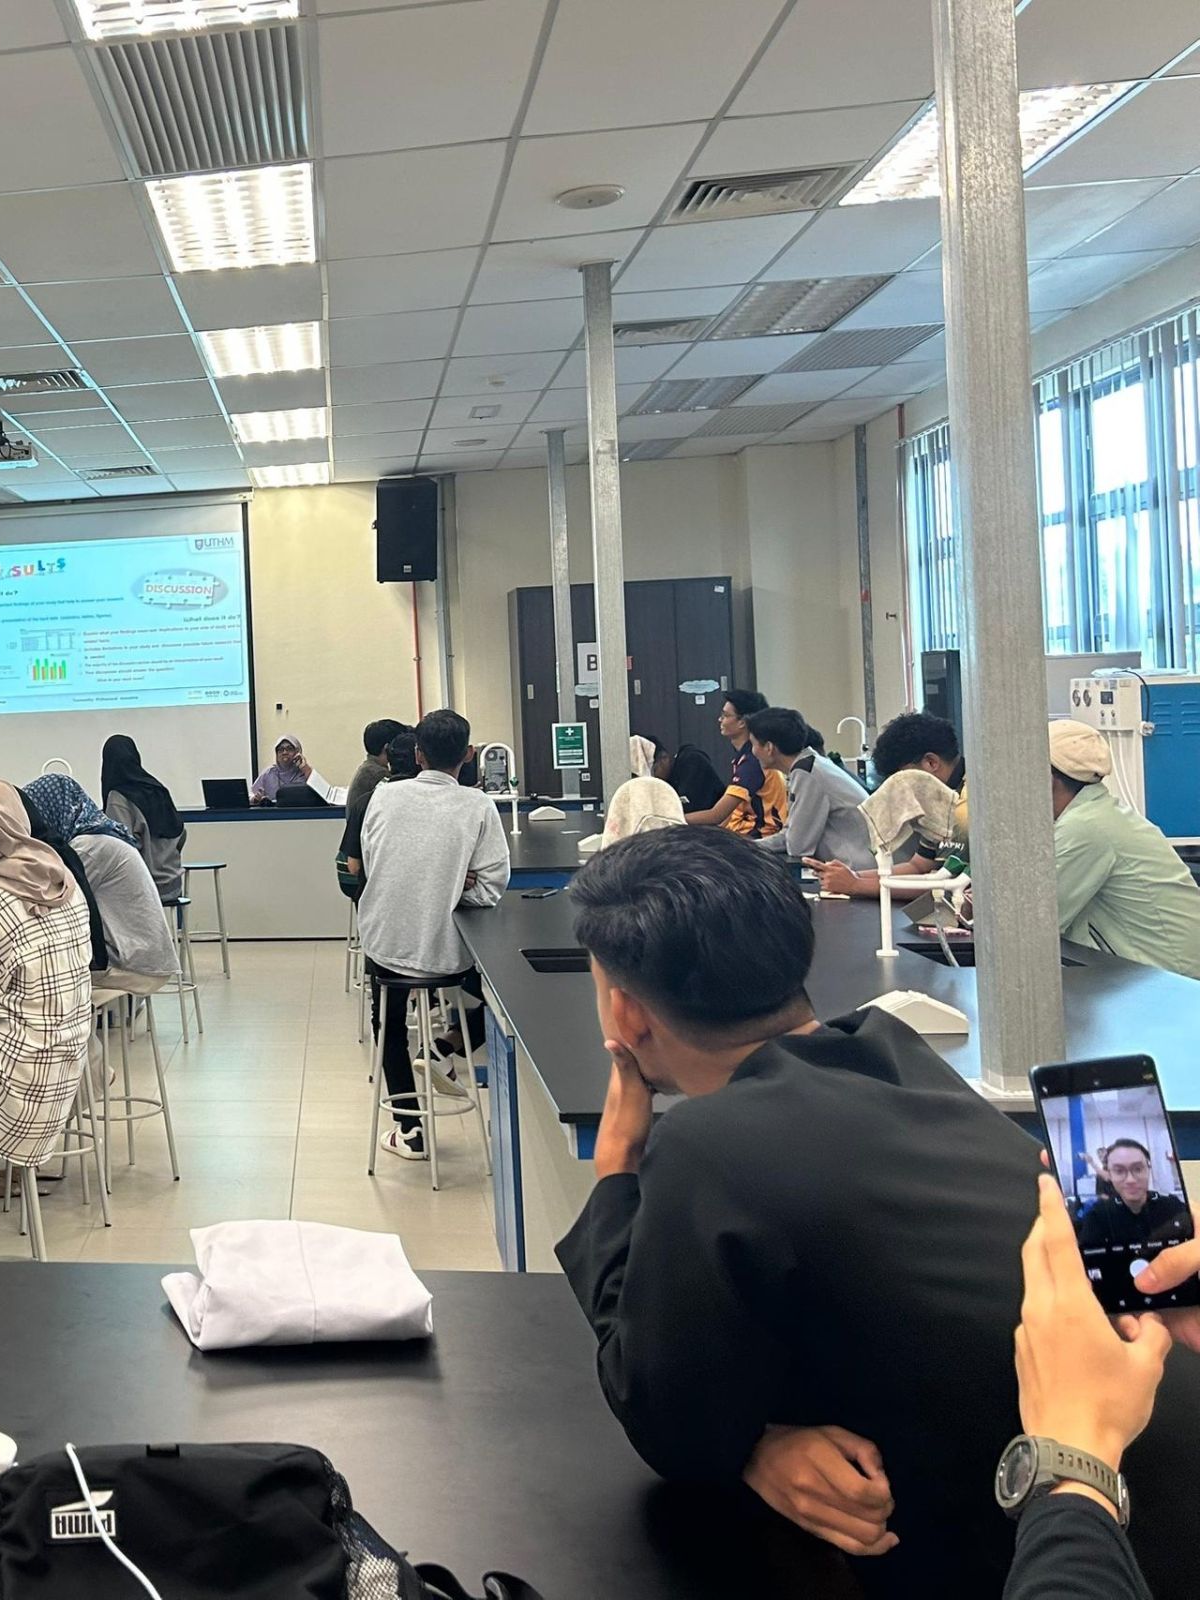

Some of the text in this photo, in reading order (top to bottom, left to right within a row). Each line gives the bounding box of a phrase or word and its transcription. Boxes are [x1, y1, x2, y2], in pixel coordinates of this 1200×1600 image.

[204, 537, 234, 546] UTHM
[145, 584, 212, 595] DISCUSSION
[587, 654, 597, 671] B
[55, 1513, 112, 1535] PUMA
